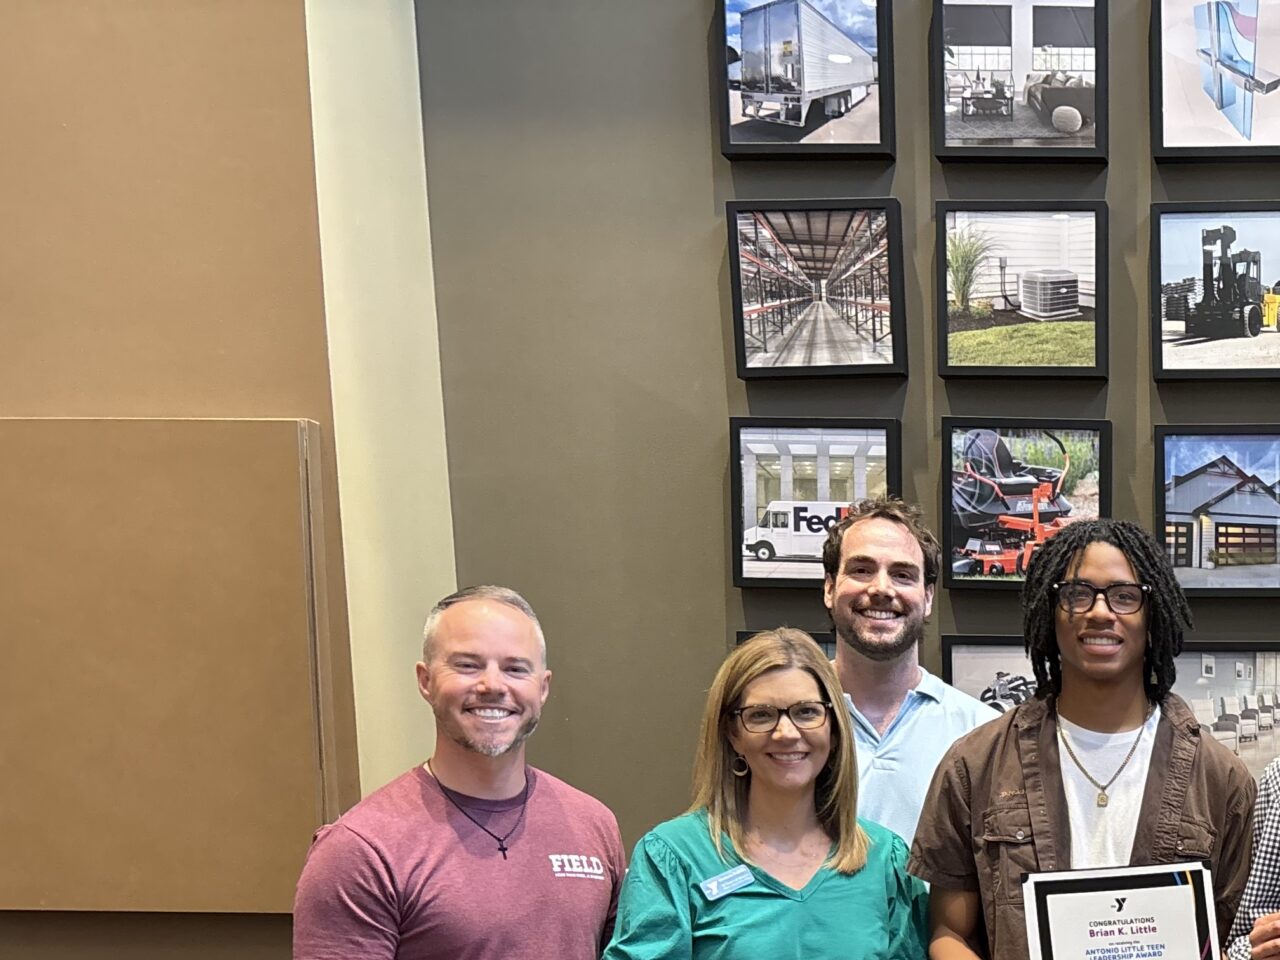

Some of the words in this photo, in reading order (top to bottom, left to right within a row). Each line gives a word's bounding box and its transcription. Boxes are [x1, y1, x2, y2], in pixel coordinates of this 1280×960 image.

[793, 506, 850, 533] Fed
[548, 854, 604, 875] FIELD
[1089, 917, 1155, 927] CONGRATULATIONS
[1089, 928, 1115, 937] Brian
[1118, 927, 1128, 936] K.
[1130, 925, 1157, 935] Little
[1085, 947, 1119, 956] ANTONIO
[1121, 945, 1145, 954] LITTLE
[1146, 943, 1166, 951] TEEN
[1135, 950, 1163, 959] AWARD
